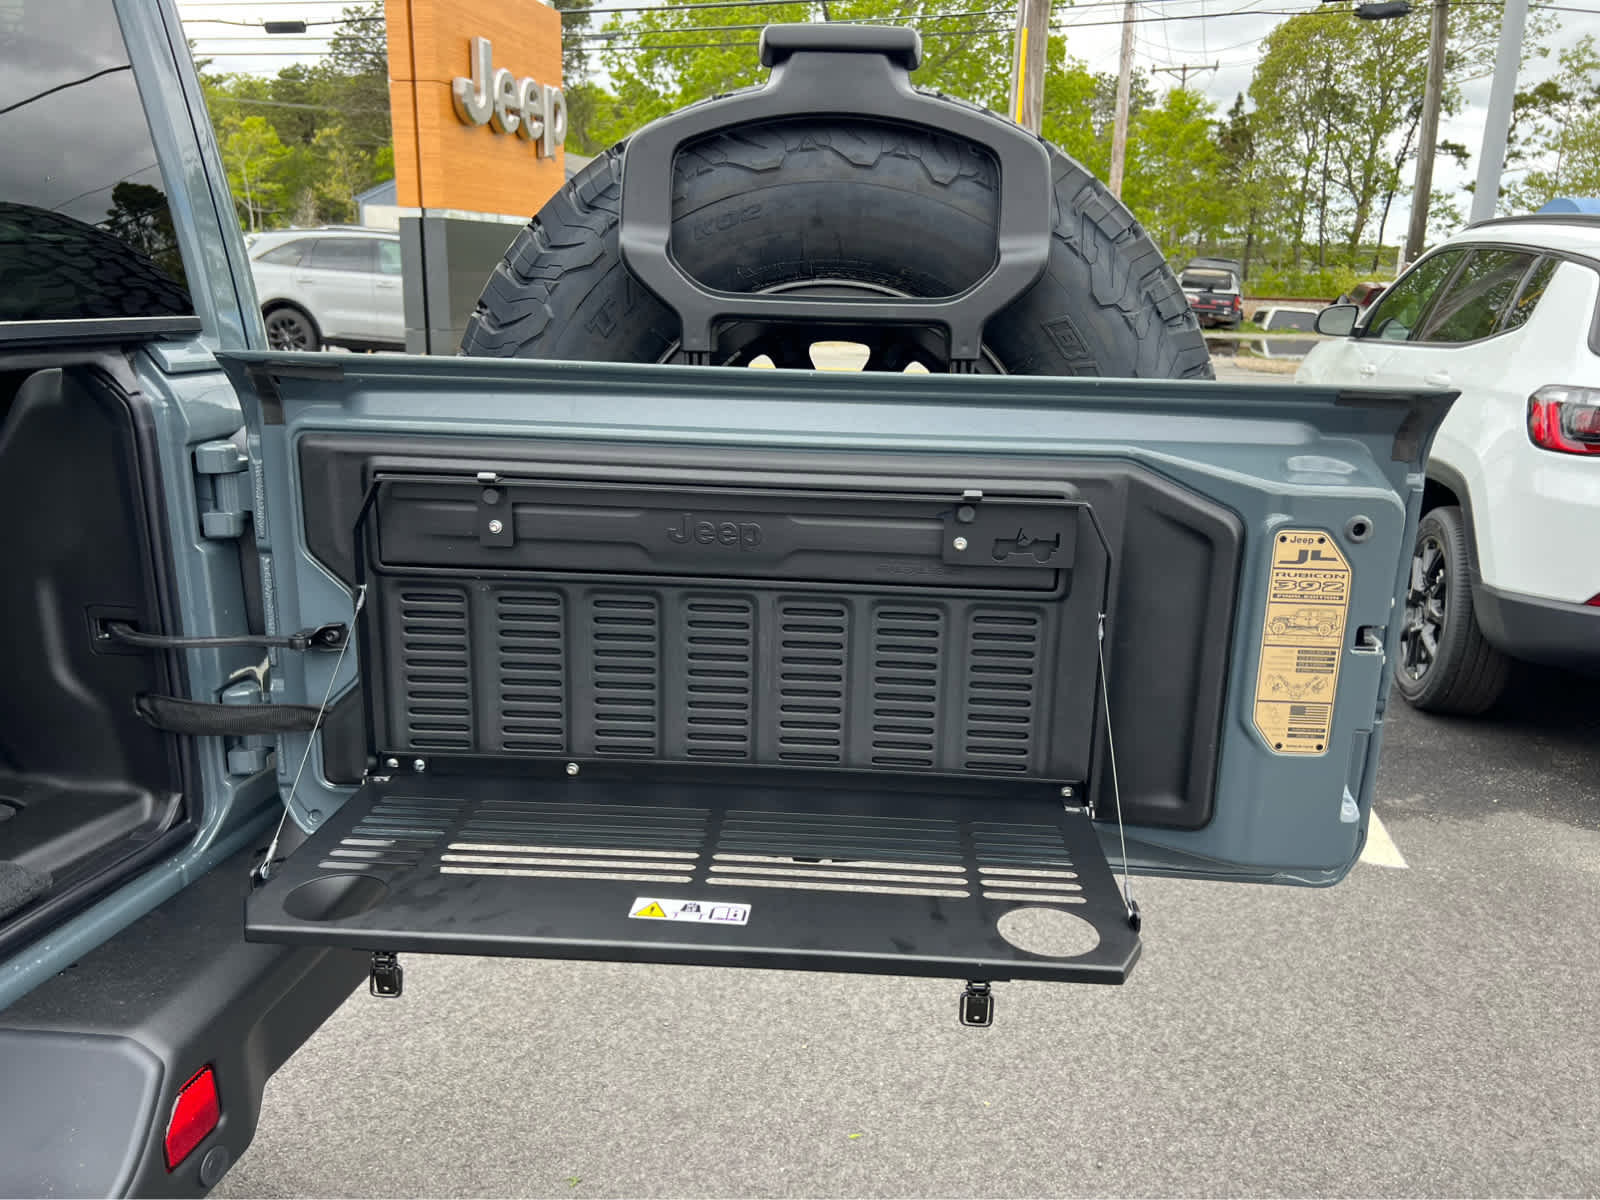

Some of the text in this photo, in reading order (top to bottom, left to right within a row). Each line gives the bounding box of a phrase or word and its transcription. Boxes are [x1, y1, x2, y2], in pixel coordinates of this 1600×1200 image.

[452, 36, 568, 160] Jeep
[665, 512, 763, 552] Jeep
[1290, 536, 1315, 545] Jeep
[1278, 549, 1339, 564] JL
[1275, 571, 1346, 579] RUBICON
[1273, 579, 1345, 593] 392
